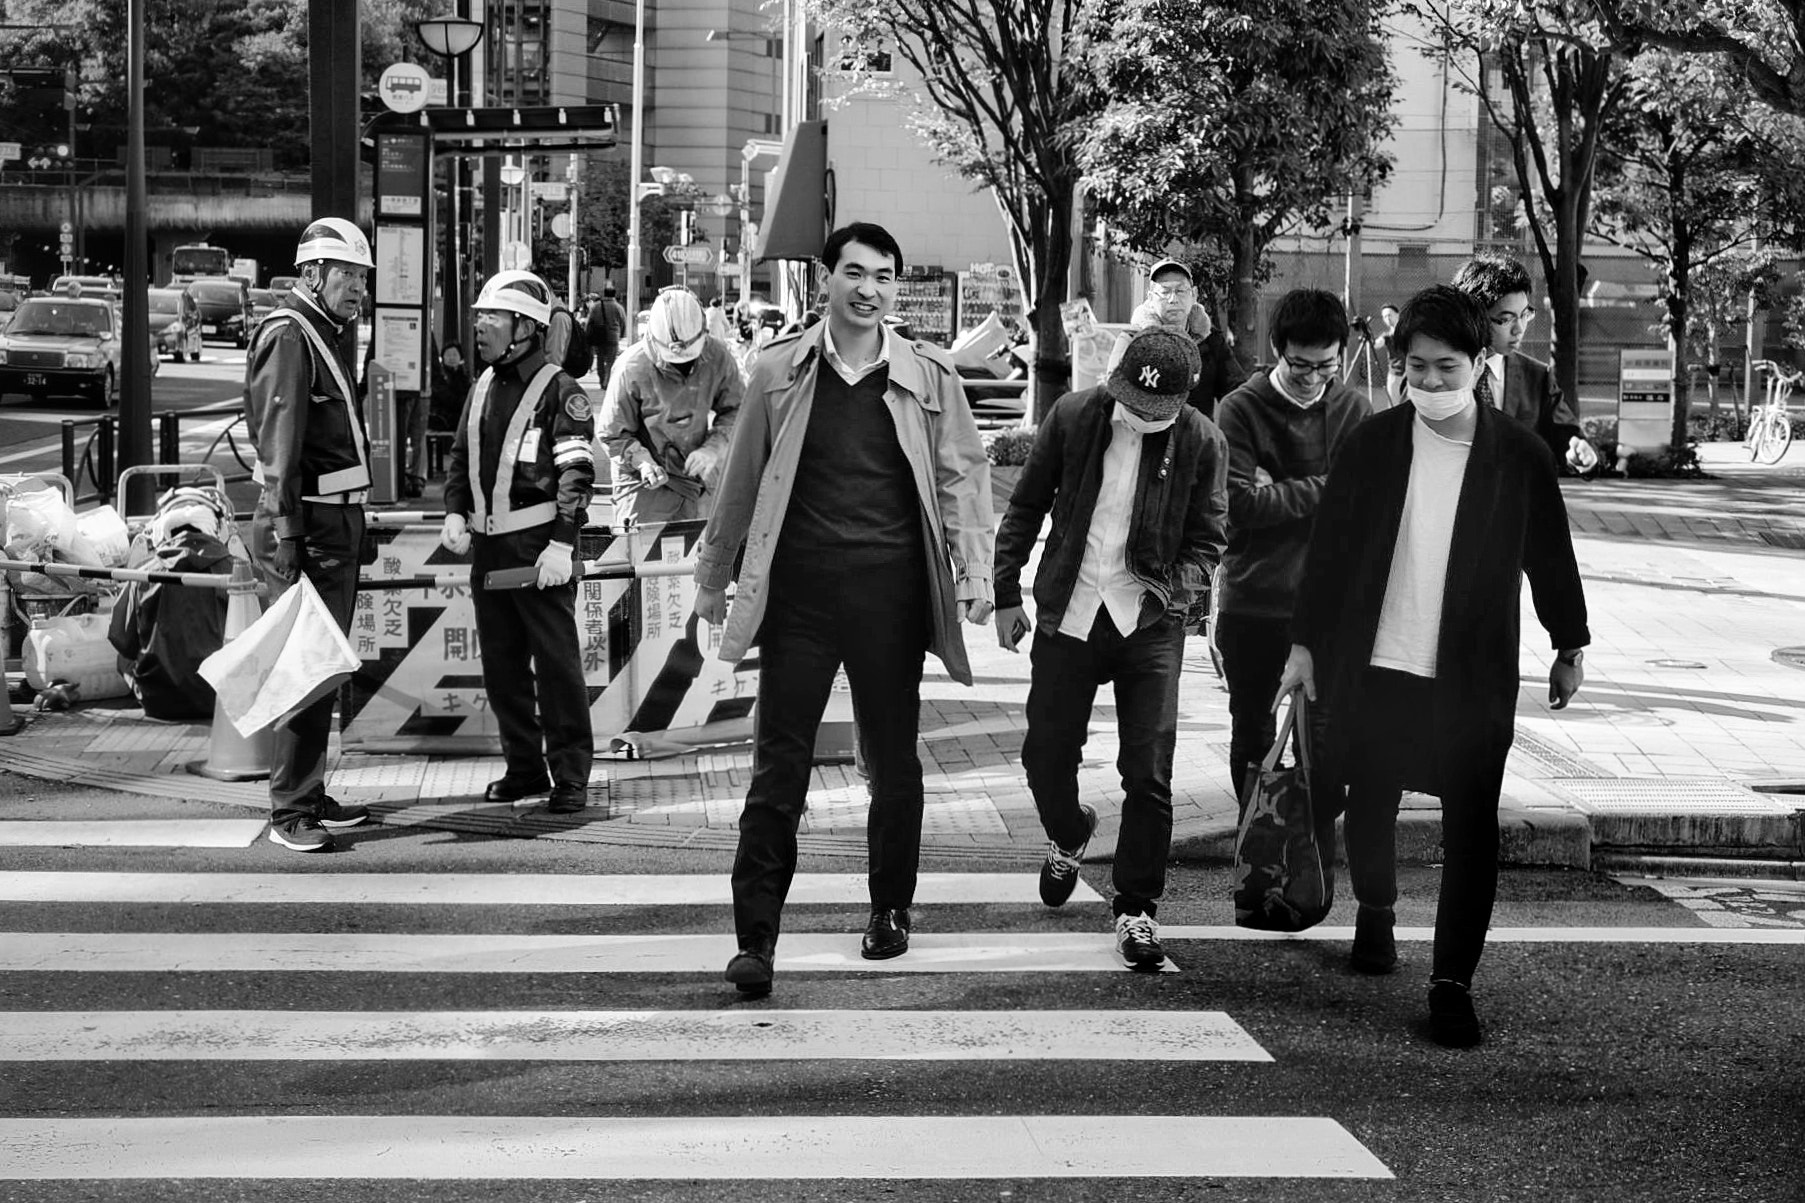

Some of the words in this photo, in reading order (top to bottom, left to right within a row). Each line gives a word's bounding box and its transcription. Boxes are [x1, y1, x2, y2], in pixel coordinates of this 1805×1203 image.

[1138, 365, 1161, 388] NY
[357, 573, 376, 653] 険場所
[583, 581, 606, 671] 関係者以外
[443, 627, 481, 661] 開
[710, 676, 758, 695] キケ
